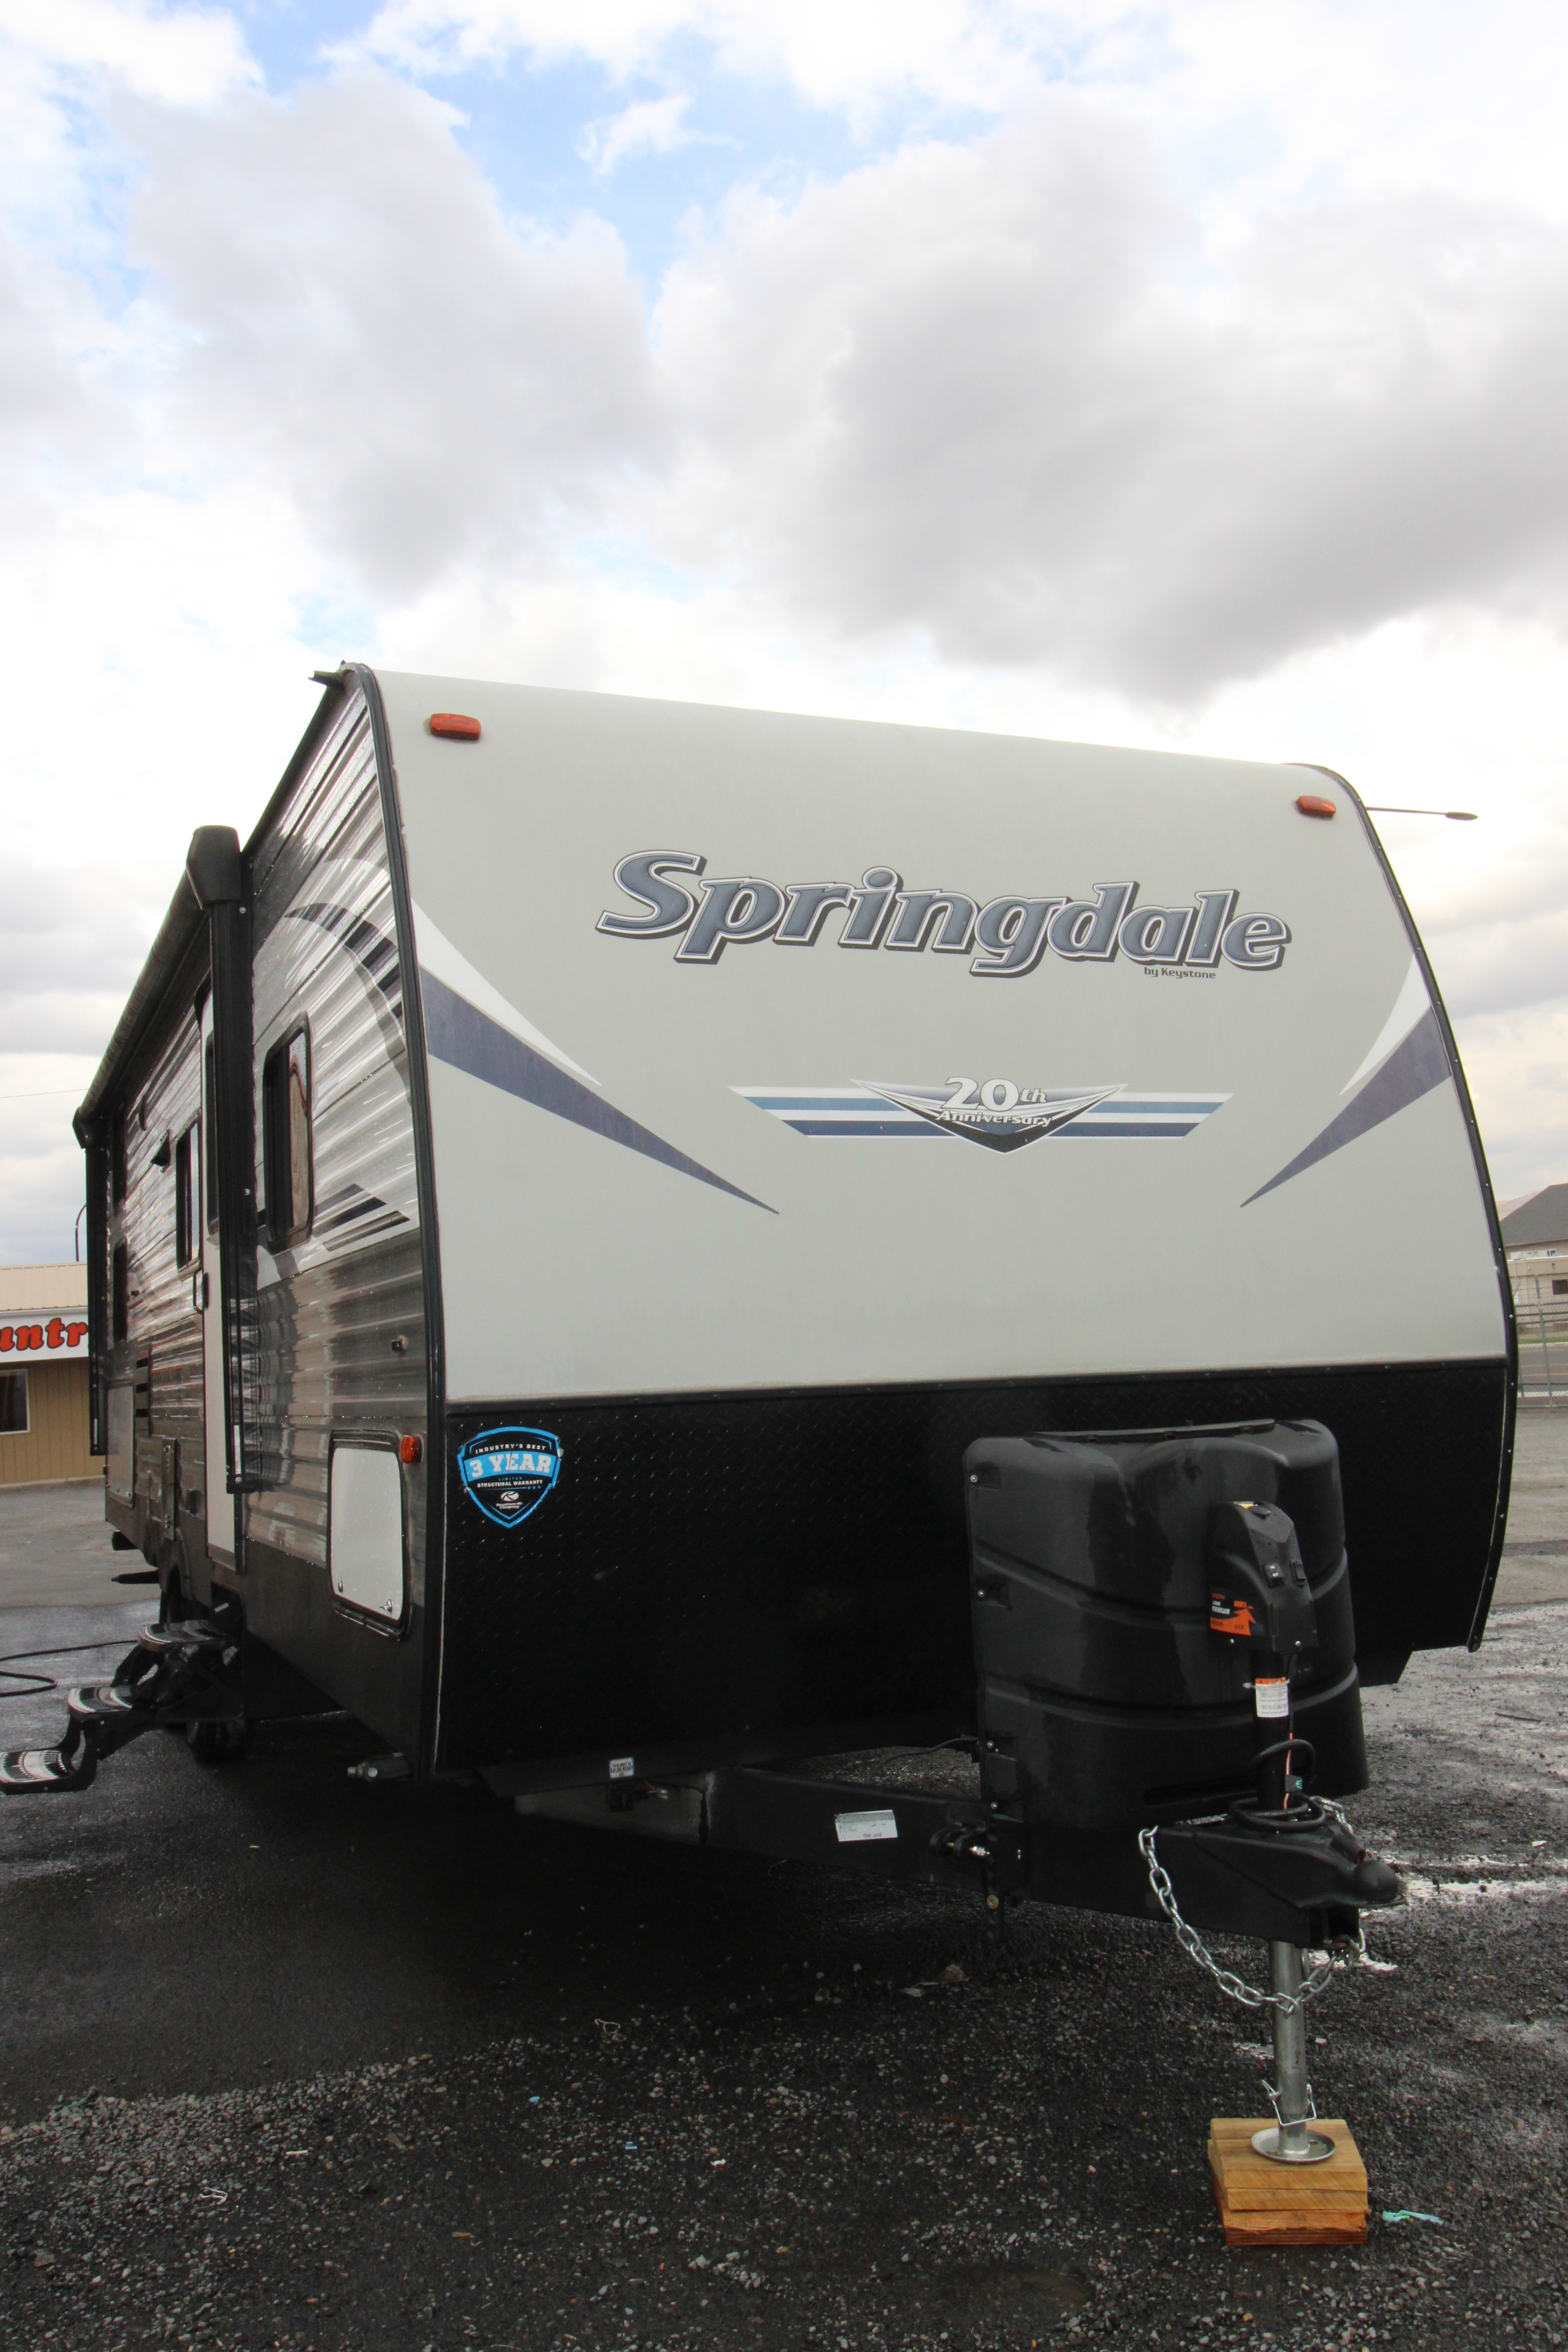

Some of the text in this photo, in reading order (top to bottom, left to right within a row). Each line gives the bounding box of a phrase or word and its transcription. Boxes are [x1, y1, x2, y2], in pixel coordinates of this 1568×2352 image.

[596, 849, 1292, 978] Springdale
[1144, 966, 1216, 979] by Keystone
[940, 1076, 1047, 1112] 20th
[935, 1110, 1053, 1127] Anniversary
[475, 1443, 523, 1454] INDUSTRY'S
[469, 1453, 552, 1478] 3 YEAR
